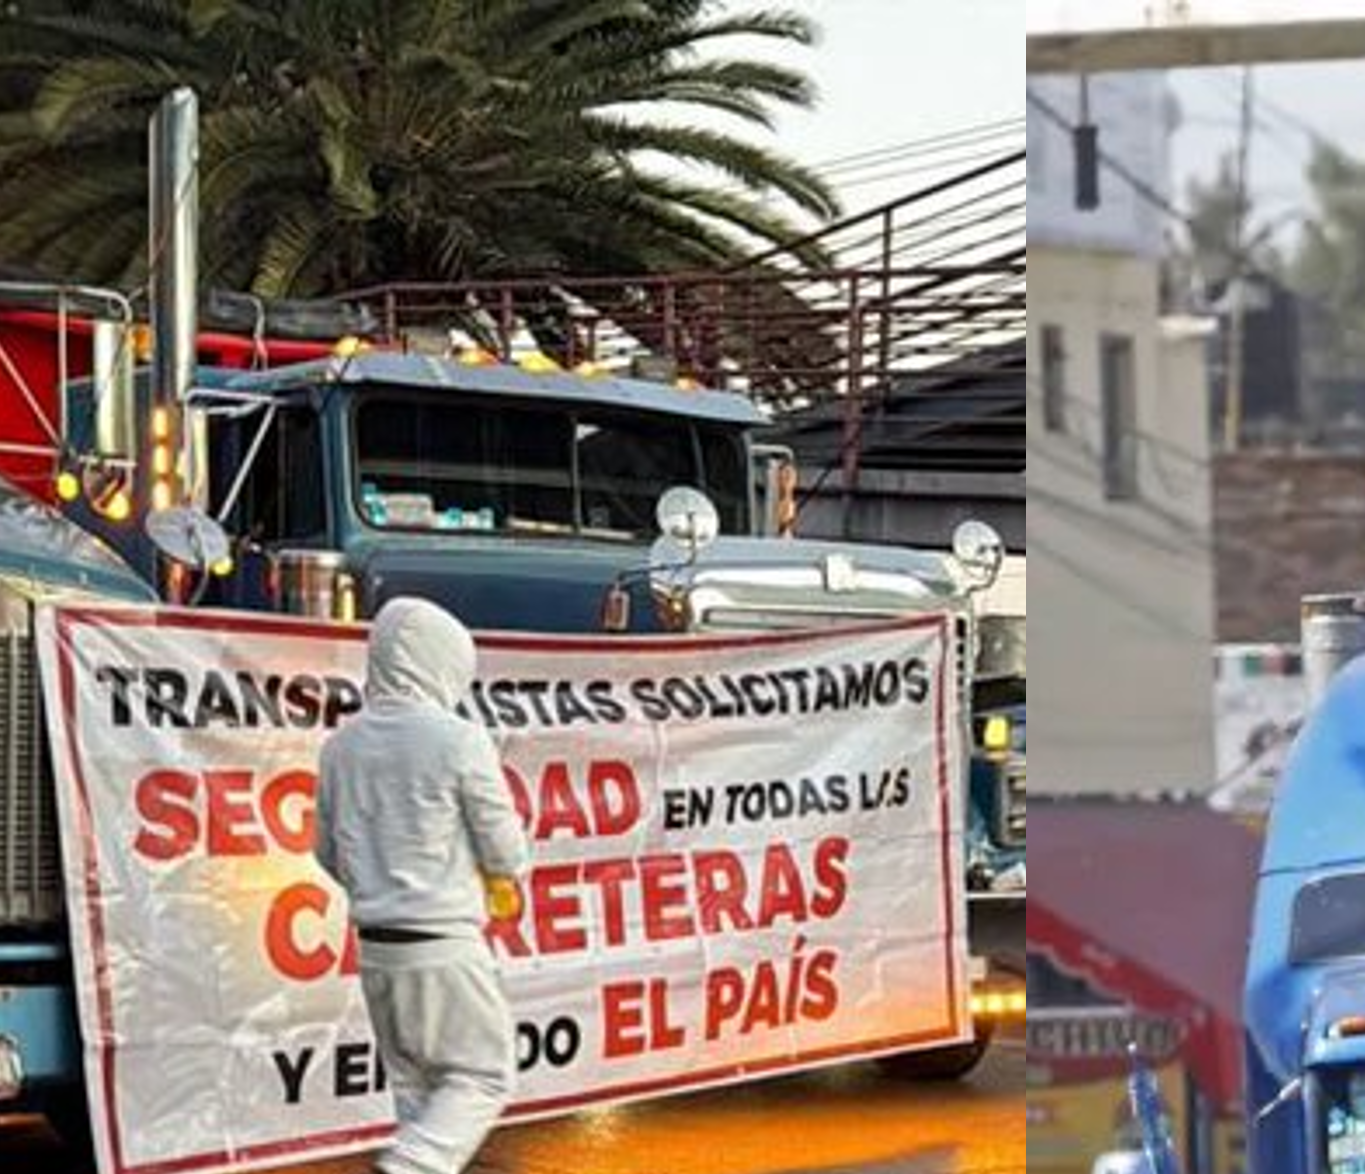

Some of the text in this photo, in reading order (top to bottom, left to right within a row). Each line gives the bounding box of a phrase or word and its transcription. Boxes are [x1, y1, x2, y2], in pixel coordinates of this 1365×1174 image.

[99, 656, 932, 729] TRANSPISTAS SOLICITAMOS
[132, 761, 639, 863] SEGAD
[664, 789, 714, 830] EN
[725, 773, 850, 825] TODAS
[264, 837, 850, 983] CRETERAS
[273, 1047, 314, 1104] Y
[516, 1016, 581, 1072] DO
[602, 980, 683, 1060] EL
[706, 934, 839, 1042] PAÍS
